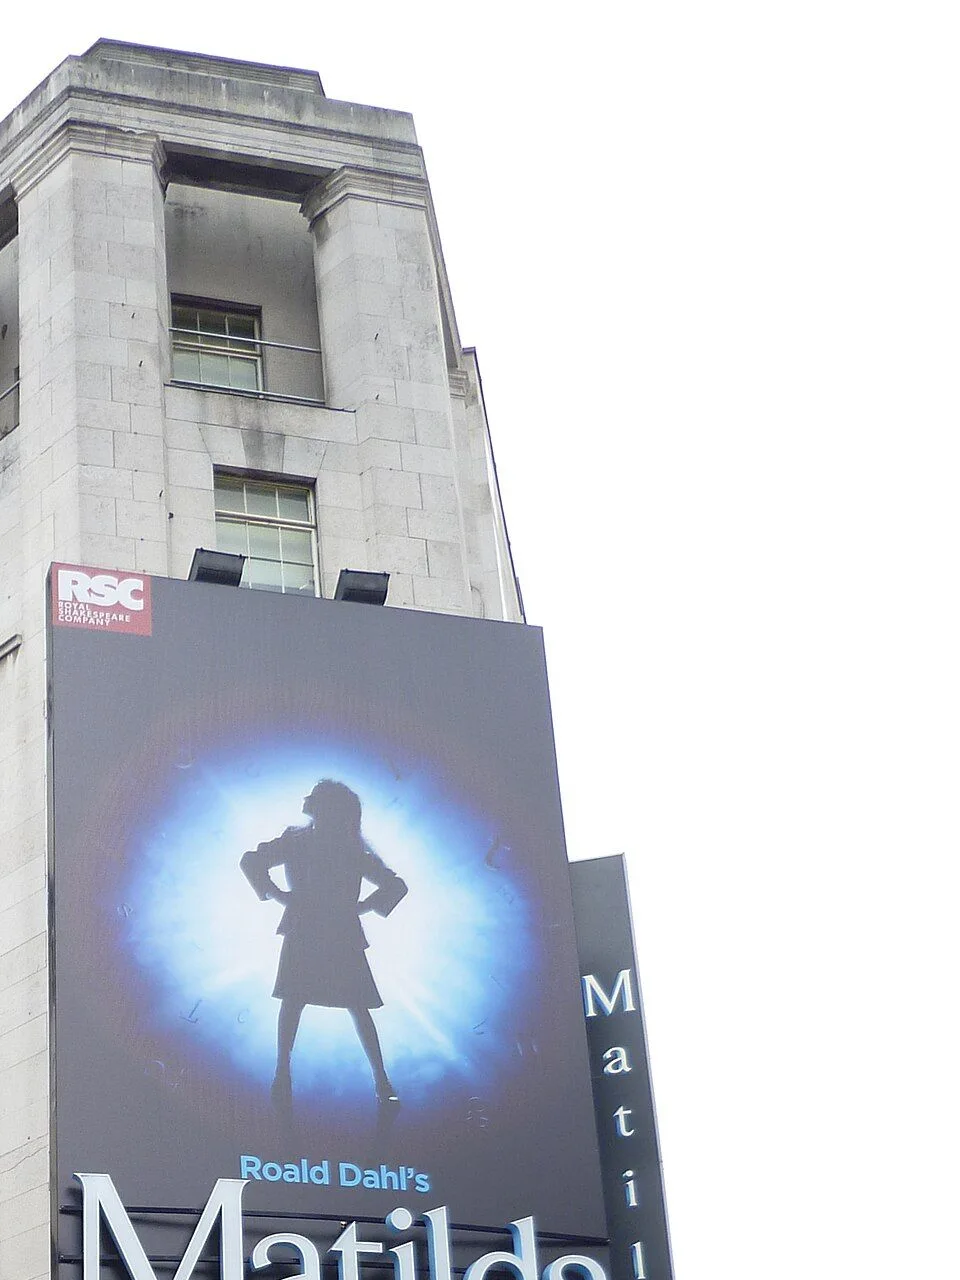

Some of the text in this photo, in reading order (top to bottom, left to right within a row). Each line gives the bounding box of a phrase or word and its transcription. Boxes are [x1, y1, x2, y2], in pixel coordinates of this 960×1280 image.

[58, 570, 144, 611] RSC
[58, 602, 91, 611] ROYAL
[58, 608, 131, 622] SHAKESPEARE
[58, 615, 110, 626] COMPANY
[240, 1156, 430, 1193] Roald Dahl's
